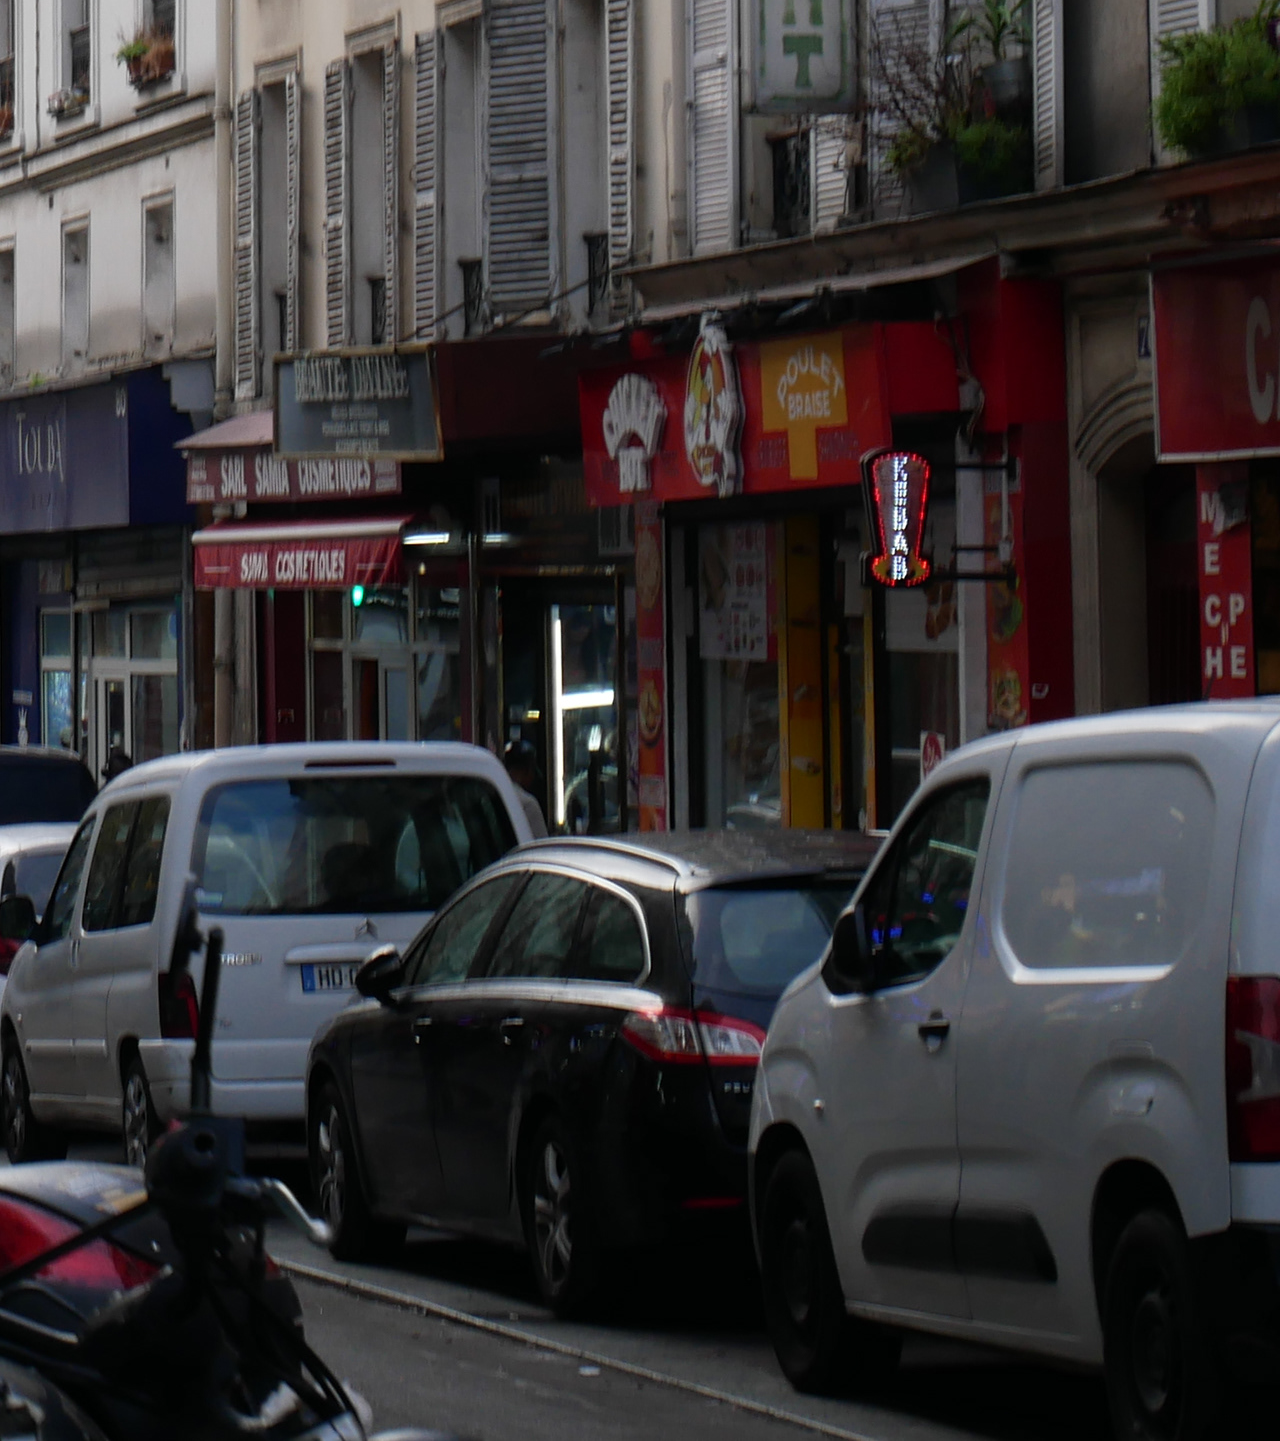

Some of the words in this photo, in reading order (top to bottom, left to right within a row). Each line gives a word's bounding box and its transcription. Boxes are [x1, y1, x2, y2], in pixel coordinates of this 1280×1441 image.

[777, 345, 844, 410] POULET
[220, 453, 247, 498] SARL
[297, 459, 371, 496] COSMETIQUES
[891, 456, 909, 580] KEBAB
